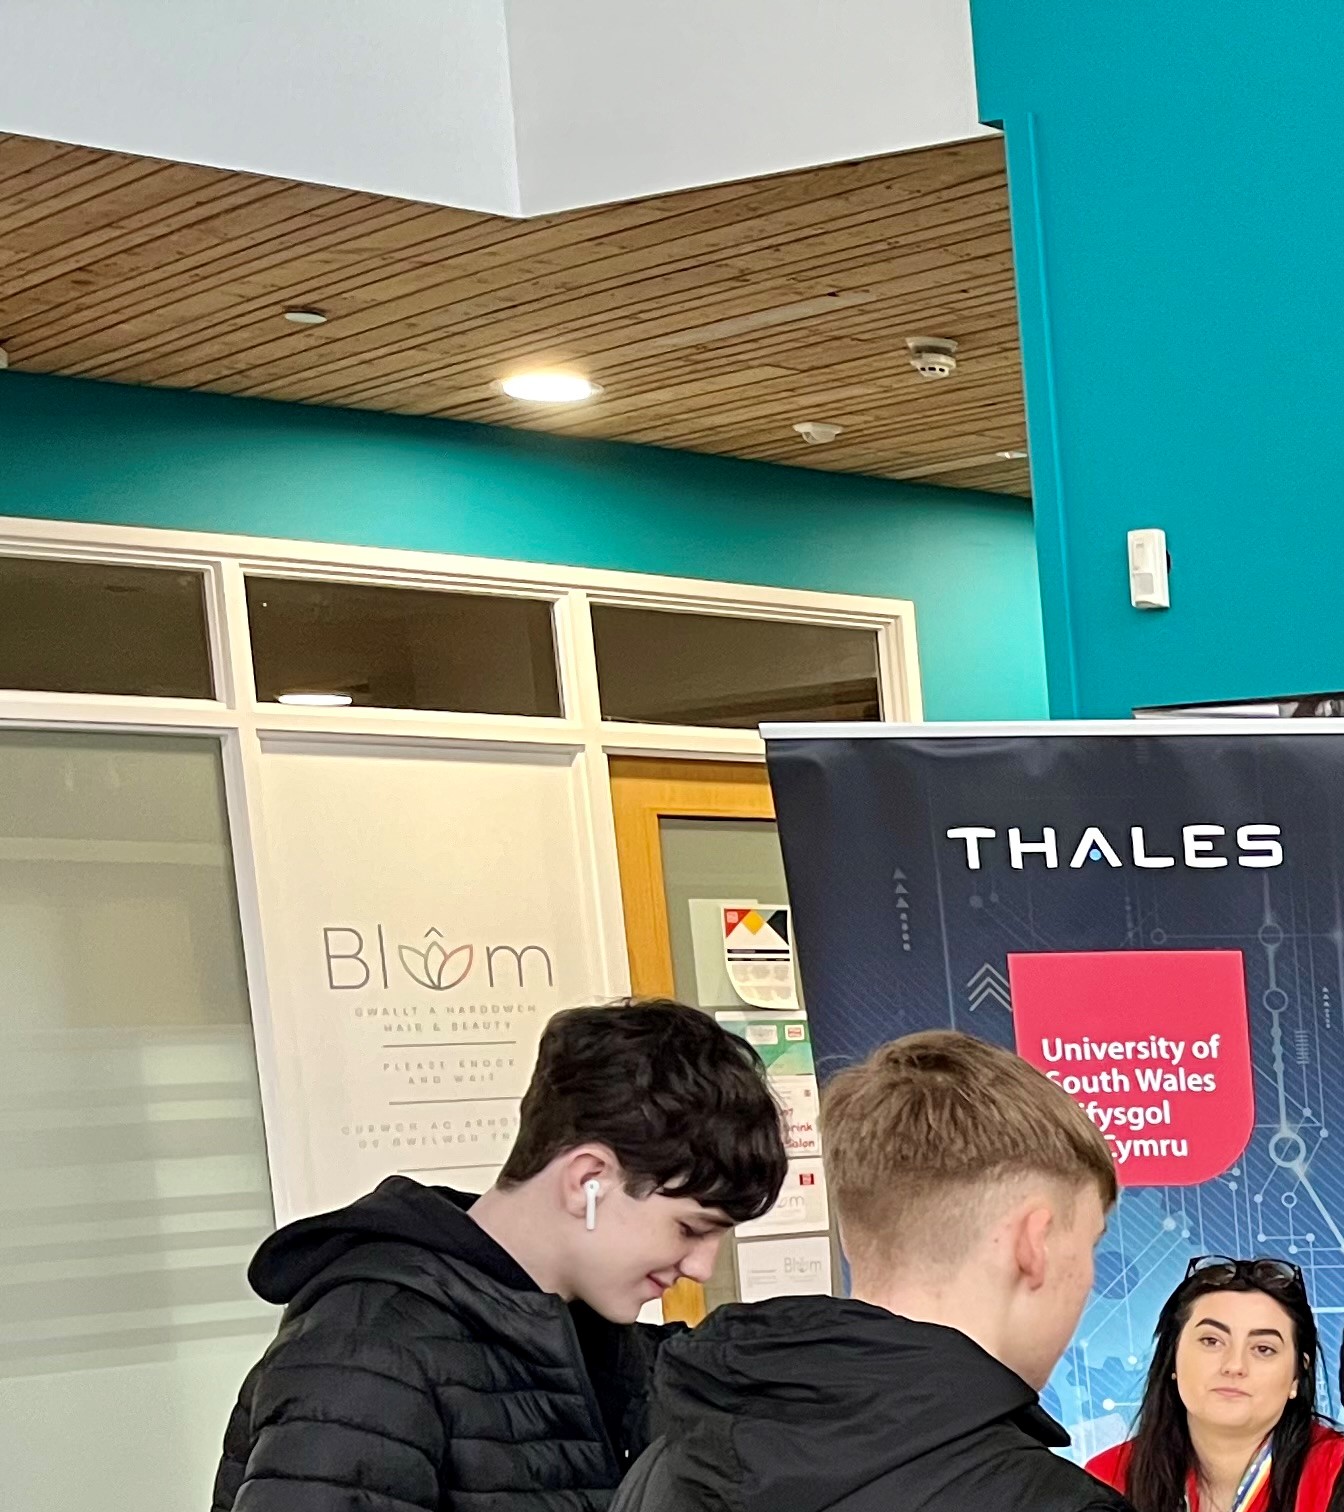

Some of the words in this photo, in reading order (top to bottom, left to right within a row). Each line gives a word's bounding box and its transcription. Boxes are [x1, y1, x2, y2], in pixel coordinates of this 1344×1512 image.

[947, 824, 1284, 869] THALES
[1042, 1036, 1185, 1065] University
[1192, 1034, 1220, 1059] of
[1135, 1067, 1216, 1092] Wales
[1079, 1100, 1171, 1132] fysgol
